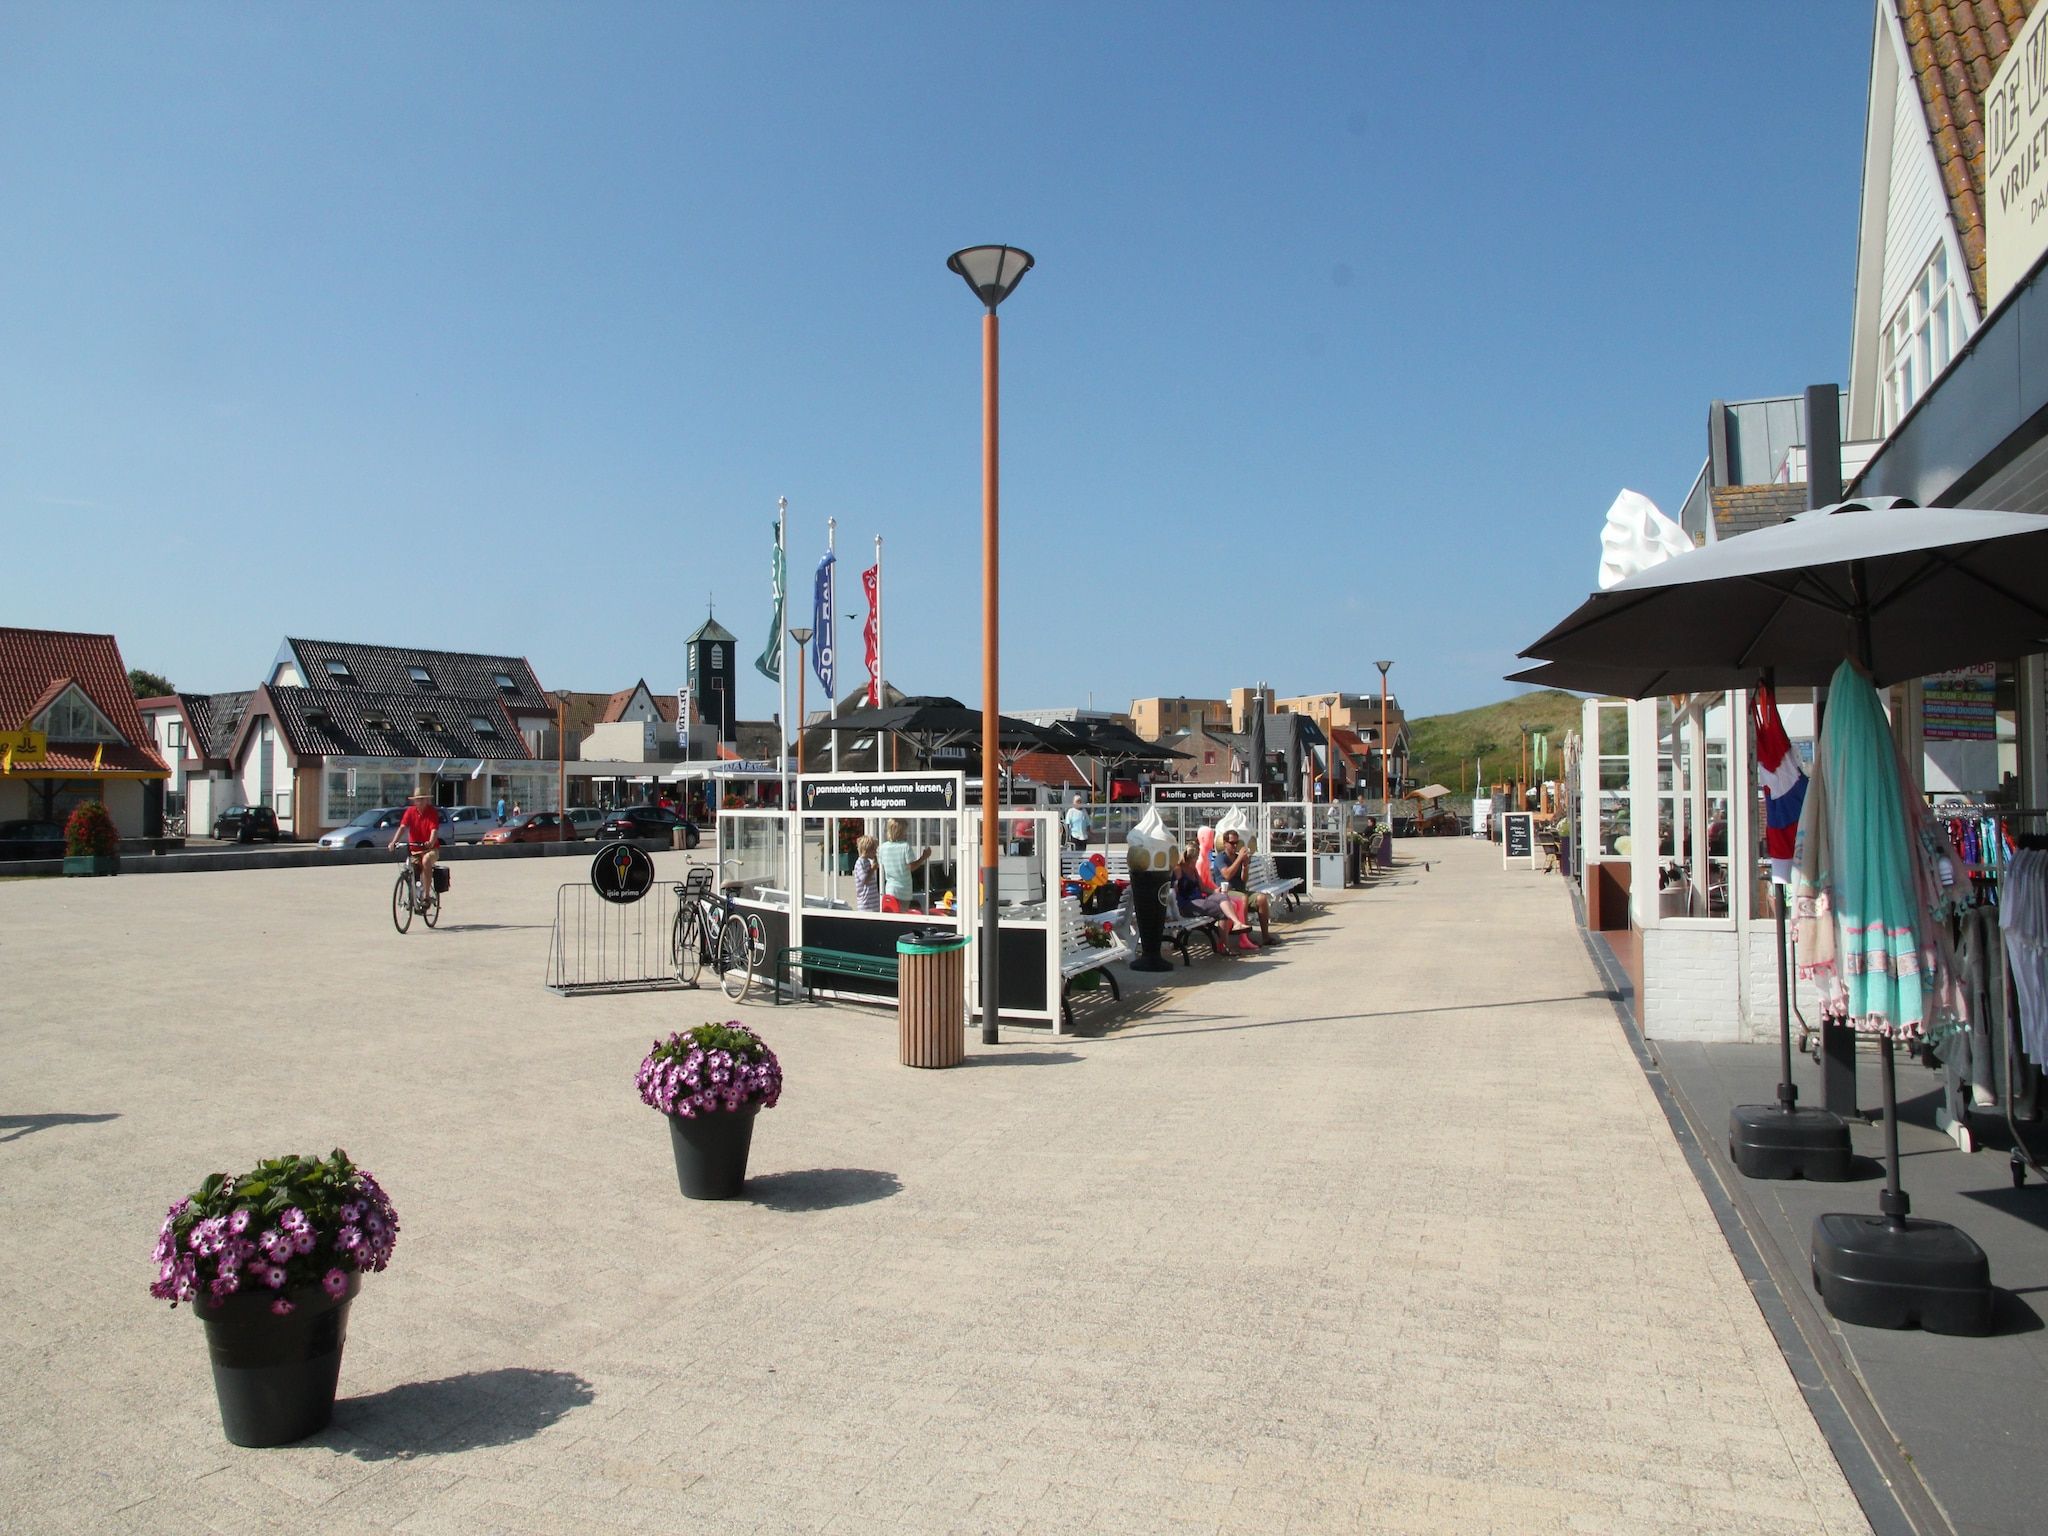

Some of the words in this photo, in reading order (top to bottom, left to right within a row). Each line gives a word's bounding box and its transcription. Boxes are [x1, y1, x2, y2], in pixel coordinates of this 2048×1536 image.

[1989, 56, 2019, 178] DE
[816, 783, 870, 796] pannenkoekjes
[871, 783, 886, 793] met
[887, 785, 914, 793] warme
[915, 782, 944, 794] kersen,
[1166, 790, 1187, 798] koffie
[1193, 790, 1215, 799] gebak
[1222, 790, 1253, 799] ijscoupes
[850, 797, 859, 809] ijs
[860, 799, 870, 807] en
[871, 797, 907, 809] slagroom
